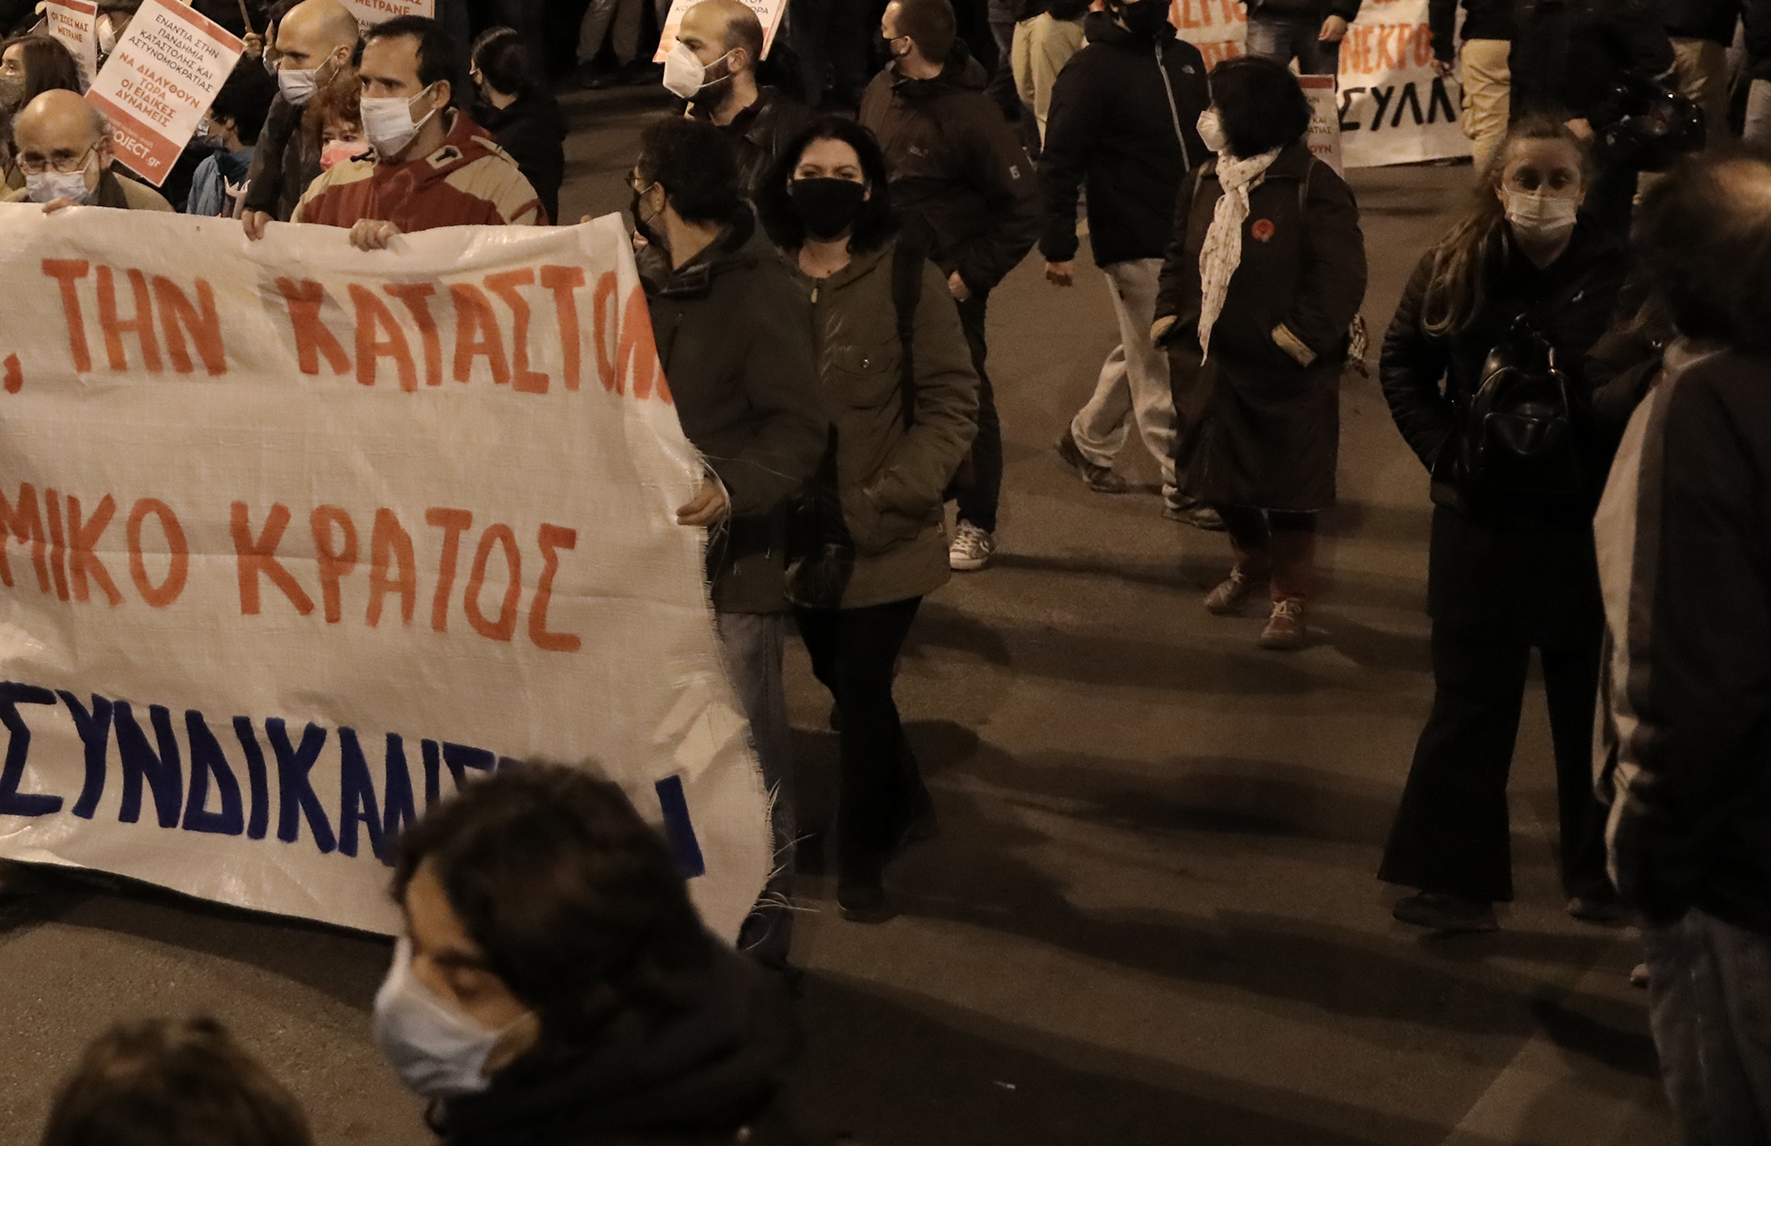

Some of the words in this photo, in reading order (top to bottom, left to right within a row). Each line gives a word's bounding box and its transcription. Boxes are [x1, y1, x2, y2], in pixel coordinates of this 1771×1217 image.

[50, 11, 59, 21] ΟΙ
[59, 14, 74, 28] ΖΩΕΣ
[74, 19, 89, 33] ΜΑΣ
[57, 25, 84, 43] ΜΕΤΡΑΝΕ
[155, 13, 195, 43] ΕΝΑΝΤΙΑ
[194, 38, 220, 60] ΣΤΗΝ
[128, 35, 214, 93] ΑΣΤΥΝΟΜΟΚΡΑΤΙΑΣ
[139, 29, 196, 70] ΚΑΤΑΣΤΟΛΗΣ
[196, 64, 214, 80] ΚΑΙ
[157, 28, 204, 62] ΠΑΝΔΗΜΙΑ
[119, 51, 135, 68] ΝΑ
[136, 61, 201, 109] ΔΙΑΛΥΘΟΥΝ
[121, 78, 133, 91] ΟΙ
[133, 86, 177, 119] ΕΙΔΙΚΕΣ
[139, 77, 166, 99] ΤΩΡΑ
[115, 89, 171, 128] ΔΥΝΑΜΕΙΣ
[41, 257, 229, 377] ΤΗΝ
[229, 499, 582, 652] ΚΡΑΤΟΣ
